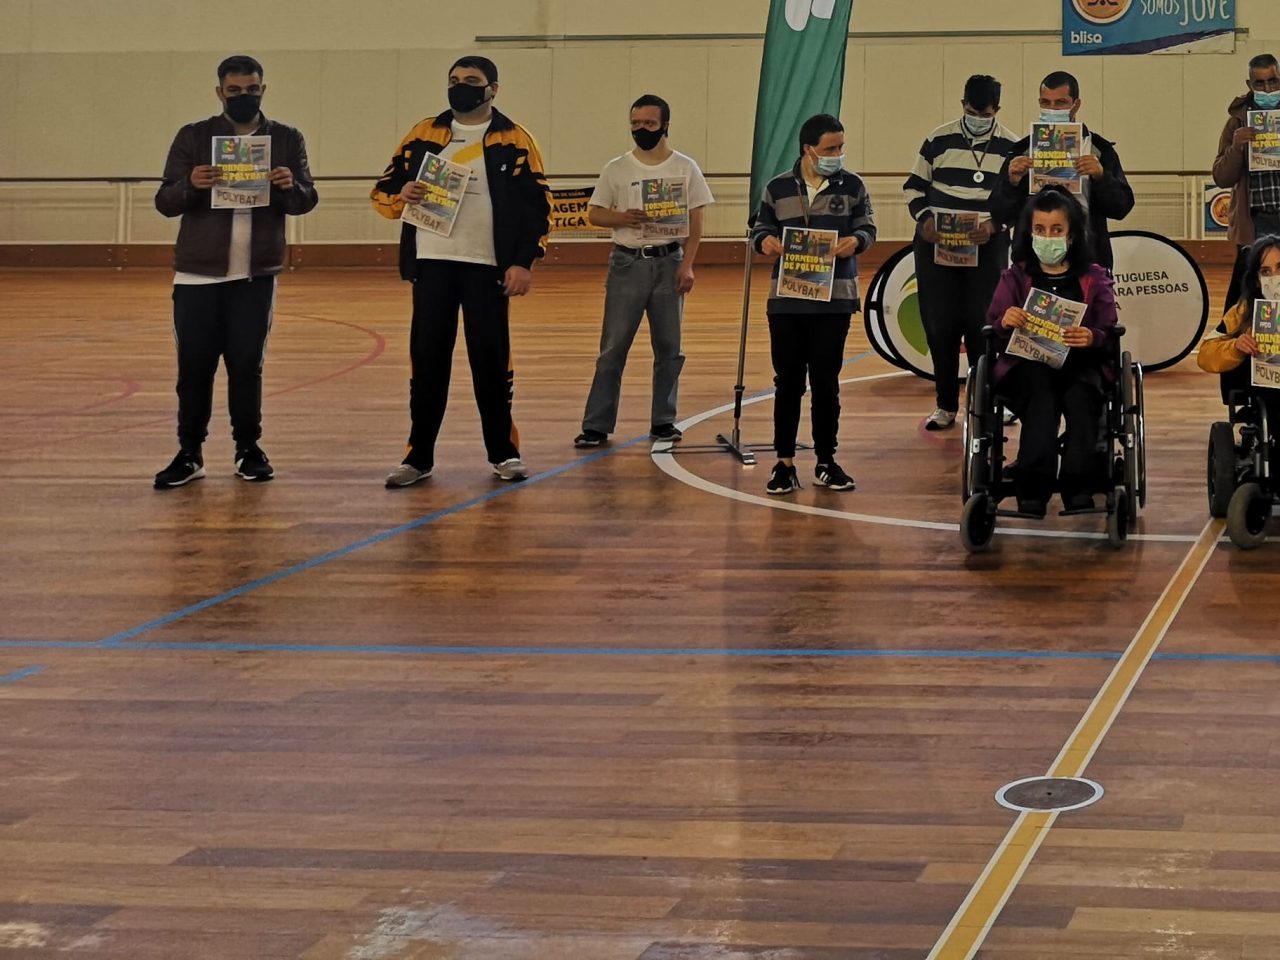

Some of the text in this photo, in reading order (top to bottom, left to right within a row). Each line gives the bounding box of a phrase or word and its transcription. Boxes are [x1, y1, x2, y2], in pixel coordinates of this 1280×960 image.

[1044, 159, 1074, 168] POLYBA
[217, 191, 258, 205] POLYBAT
[645, 224, 679, 236] POLYBAT
[785, 253, 820, 263] TORNEIO
[784, 261, 831, 273] DE POLYBAT
[1115, 271, 1169, 284] TUGUESA
[782, 278, 820, 299] POLYBAT
[1136, 283, 1189, 296] PESSOAS
